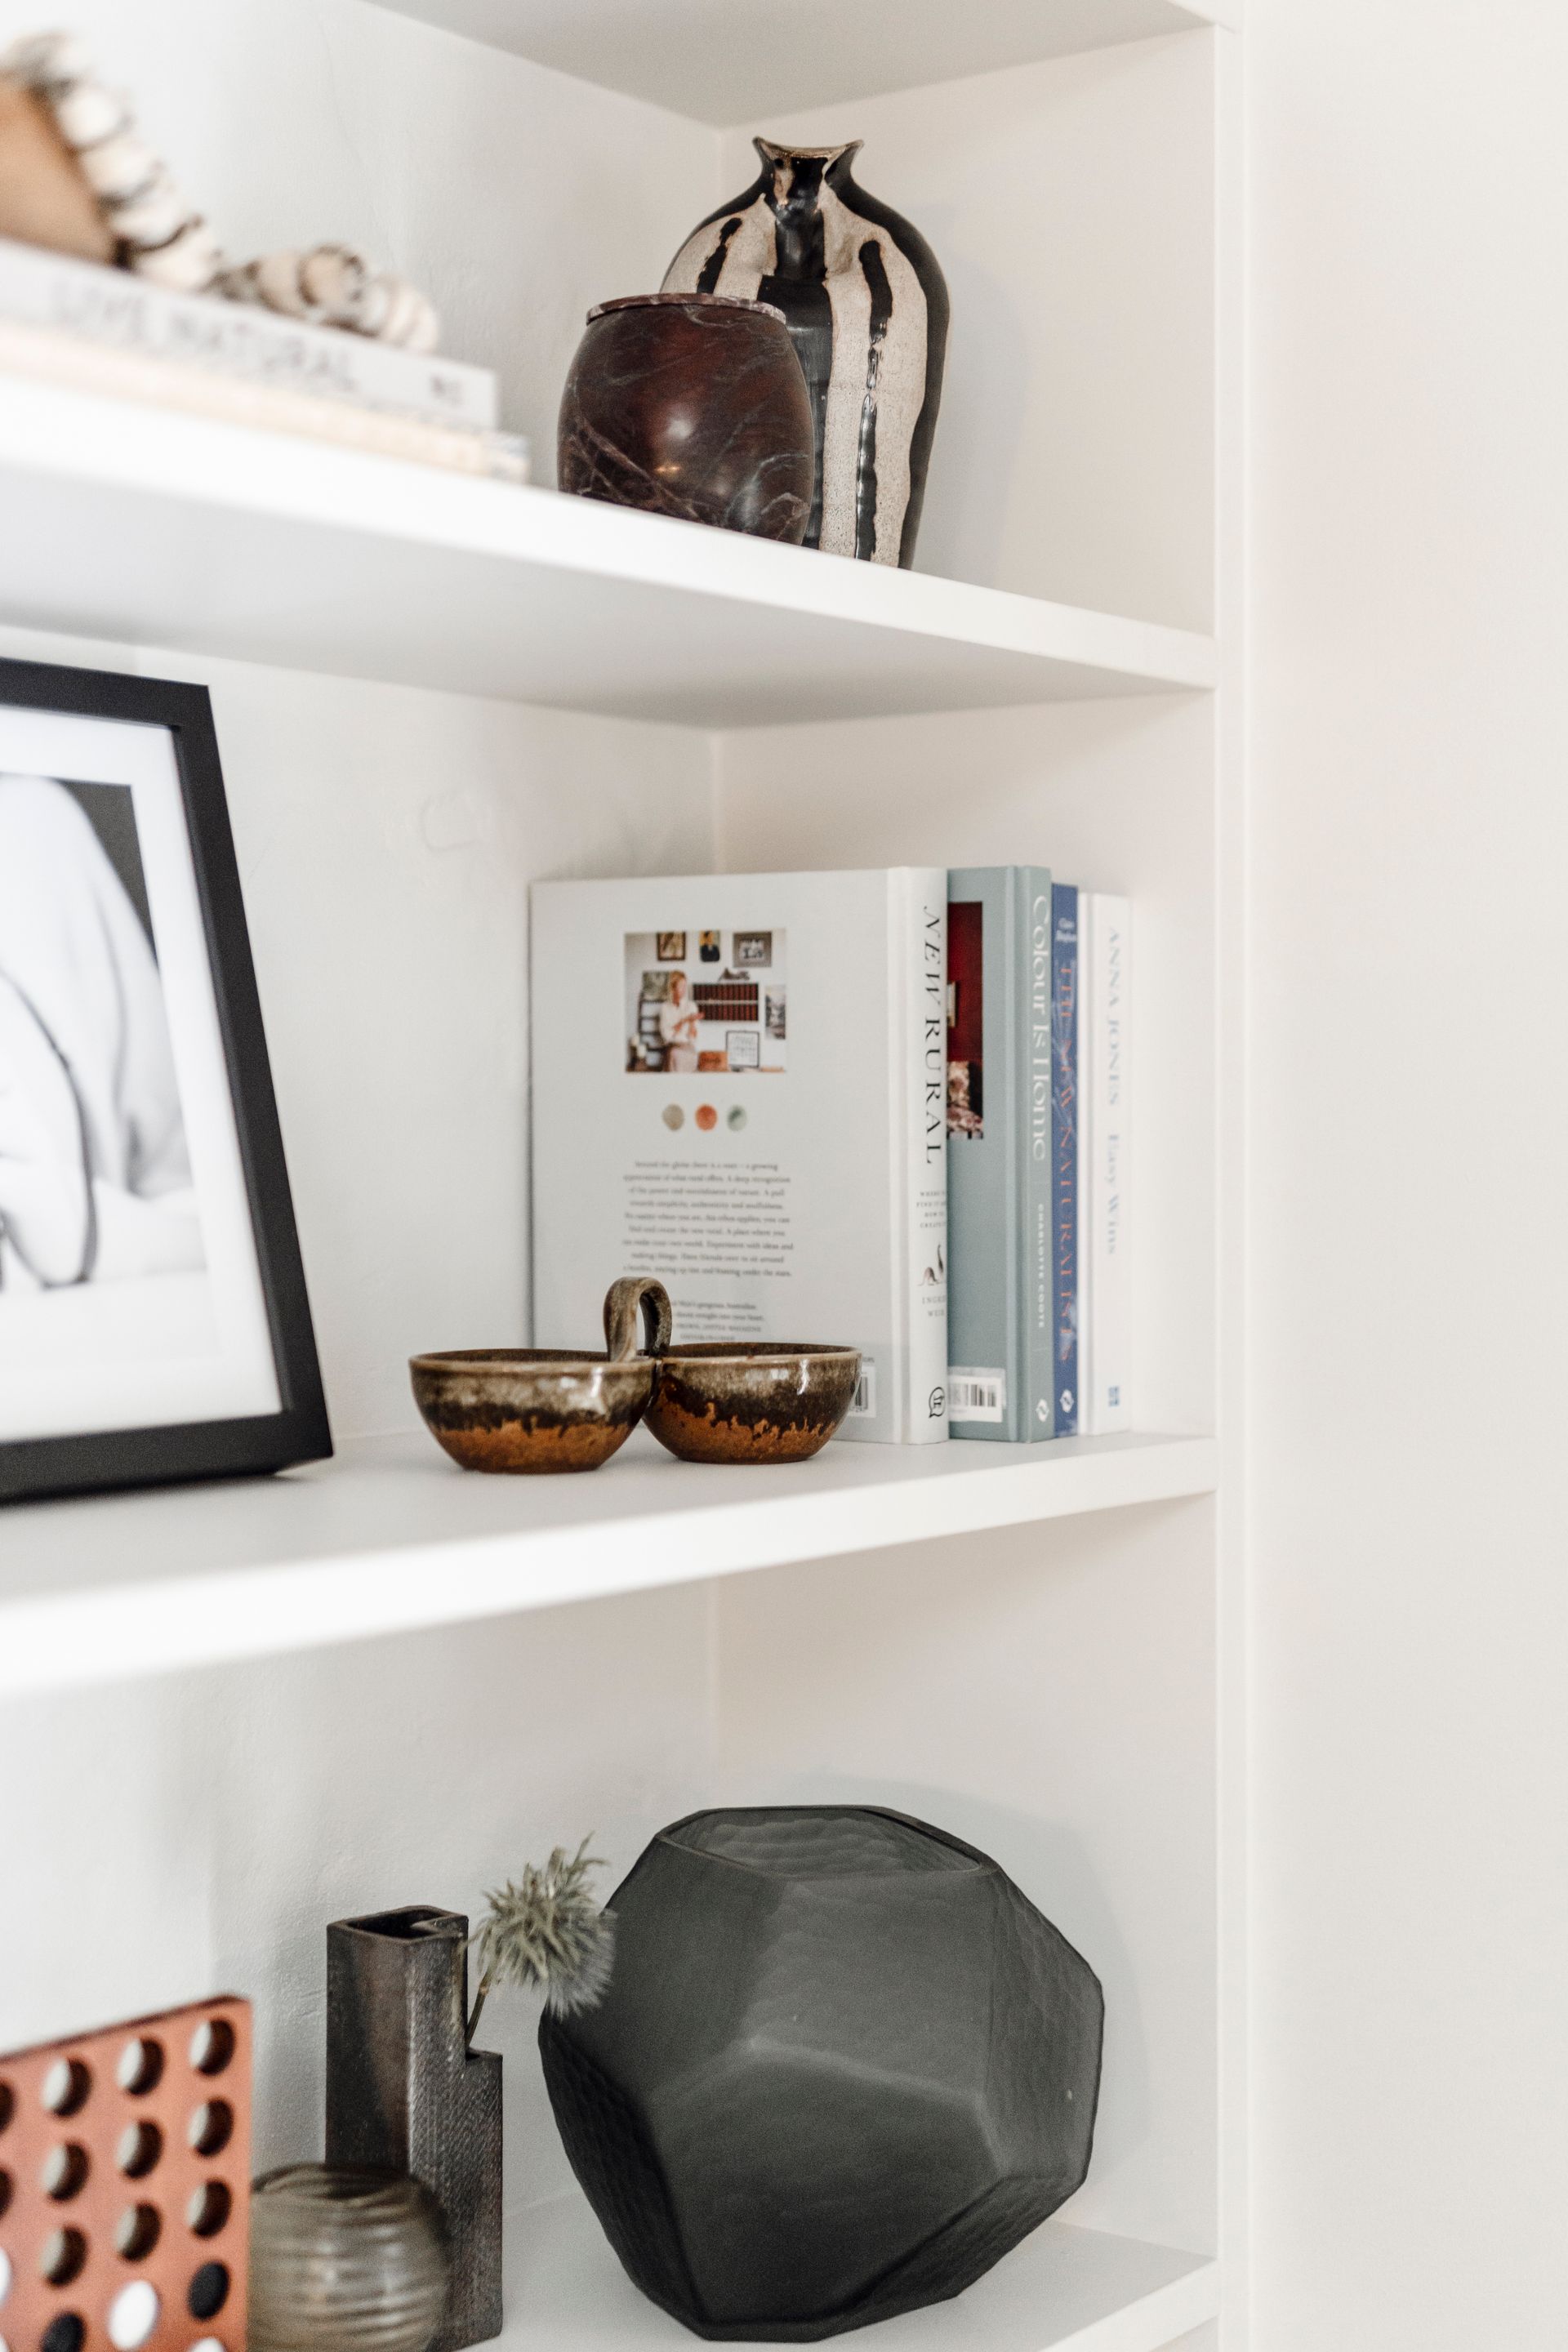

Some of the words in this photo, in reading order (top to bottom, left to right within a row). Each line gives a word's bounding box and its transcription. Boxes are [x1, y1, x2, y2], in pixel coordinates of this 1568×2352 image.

[924, 906, 942, 1007] NEW
[1033, 895, 1049, 1015] Colour
[1108, 929, 1120, 1007] ANNA
[1033, 1024, 1049, 1049] Is
[1107, 1019, 1120, 1106] JONES
[924, 1018, 942, 1165] RURAL
[1033, 1058, 1050, 1162] Home
